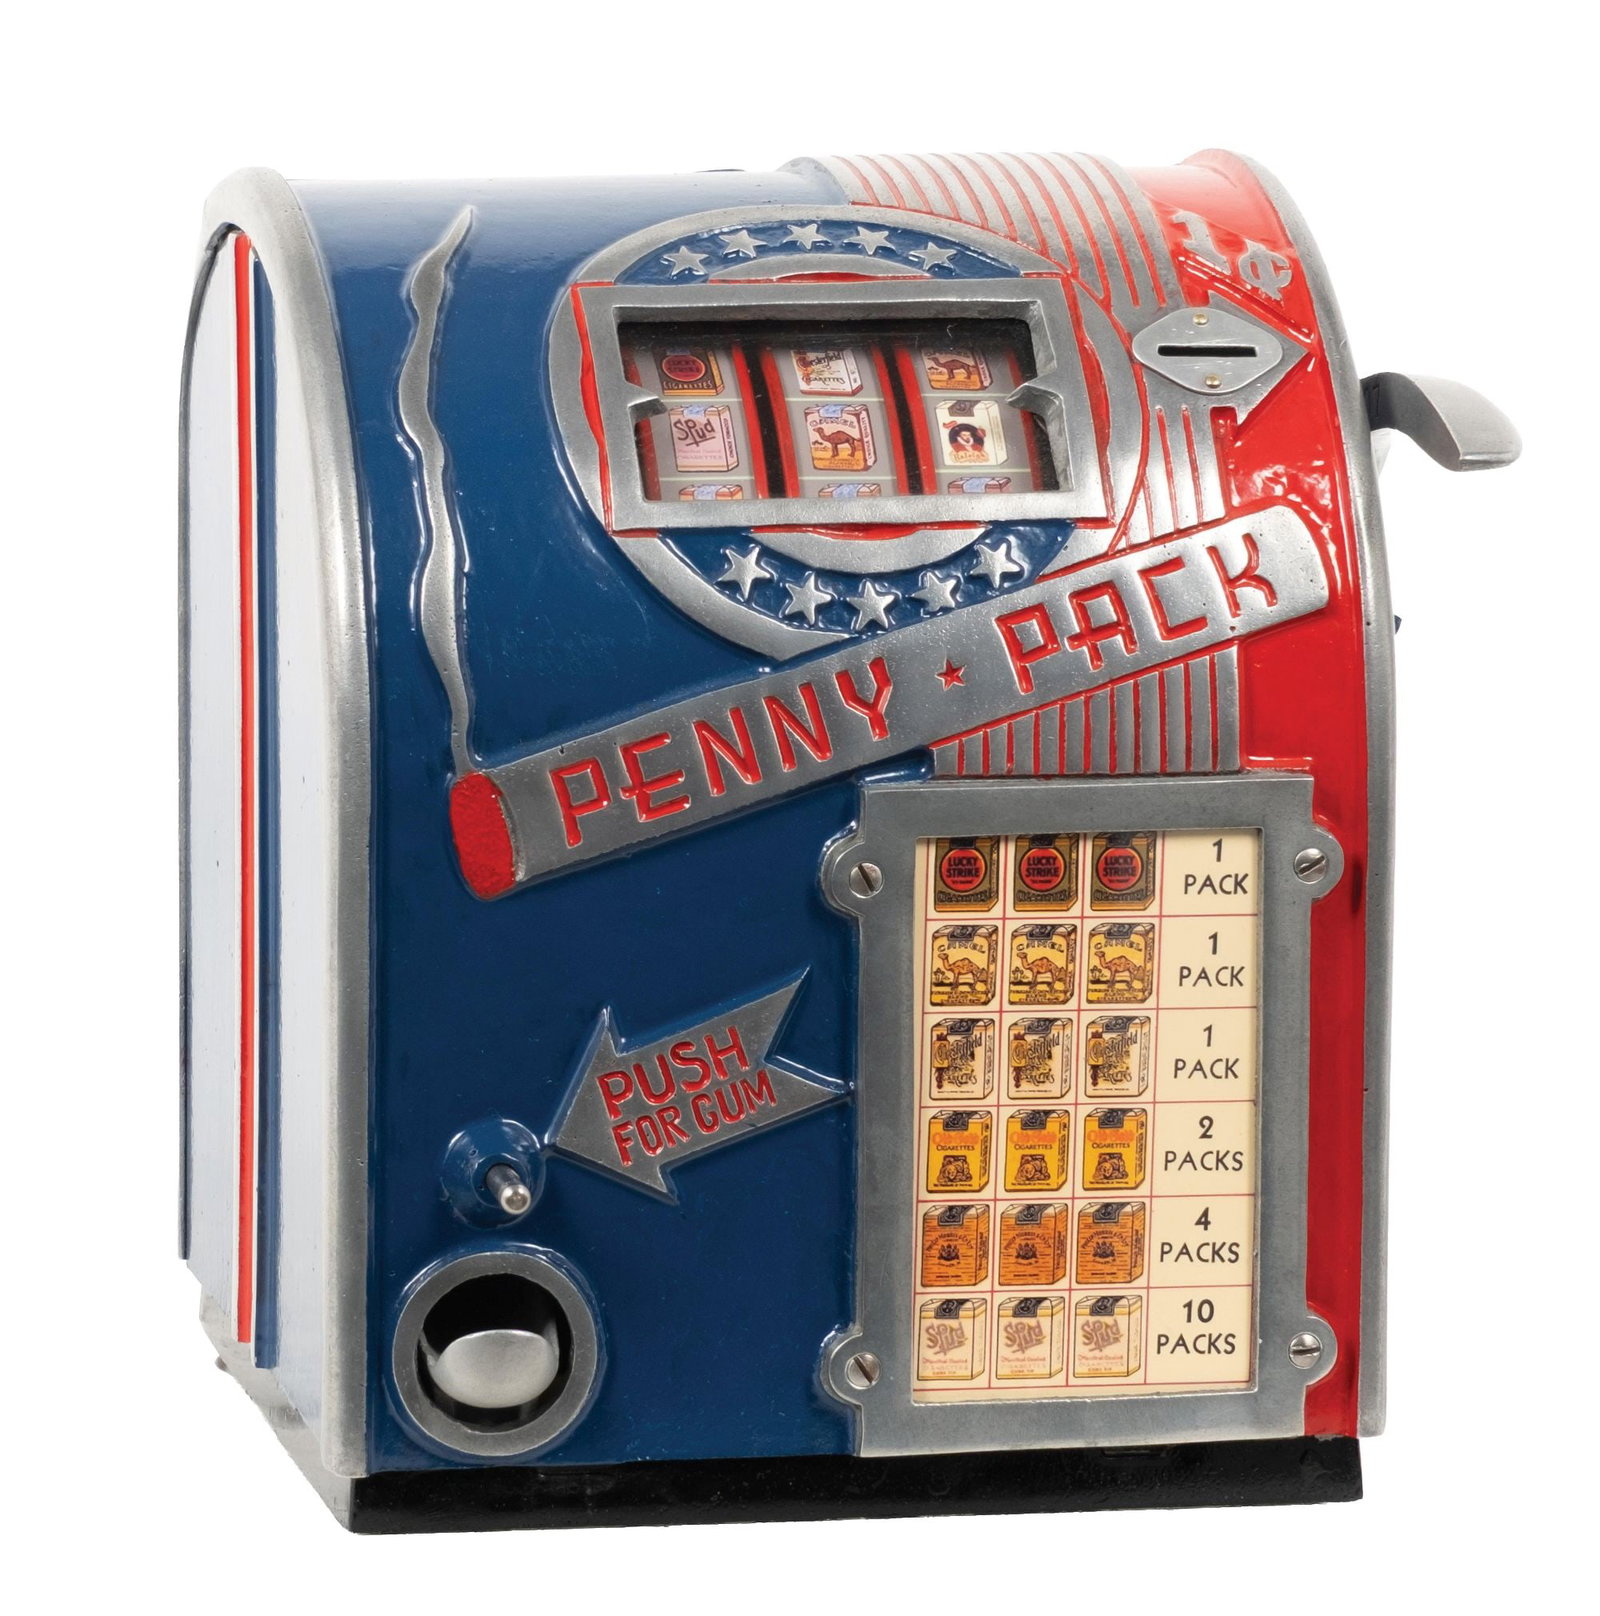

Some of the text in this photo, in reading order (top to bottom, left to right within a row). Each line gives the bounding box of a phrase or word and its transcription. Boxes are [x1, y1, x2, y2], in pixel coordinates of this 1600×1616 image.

[547, 532, 1280, 847] PENNY PACK
[948, 856, 978, 866] LUCKY
[1027, 856, 1057, 866] LUCKY
[1104, 855, 1135, 866] LUCKY
[1212, 838, 1223, 863] 1
[946, 867, 980, 878] STRIKE
[1026, 867, 1059, 877] STRIKE
[1102, 866, 1137, 877] STRIKE
[1183, 873, 1249, 895] PACK
[1208, 931, 1218, 955] 1
[1178, 966, 1245, 987] PACK
[1203, 1024, 1213, 1048] 1
[596, 1025, 750, 1120] PUSH
[1173, 1057, 1240, 1079] PACK
[610, 1068, 777, 1167] FOR GUM
[1198, 1115, 1214, 1140] 2
[936, 1143, 975, 1151] CIGARETTES
[1014, 1143, 1053, 1151] CIGARETTES
[1164, 1150, 1244, 1172] PACKS
[1194, 1207, 1212, 1231] 4
[1160, 1241, 1241, 1264] PACKS
[1183, 1298, 1215, 1324] 10
[1156, 1333, 1237, 1355] PACKS
